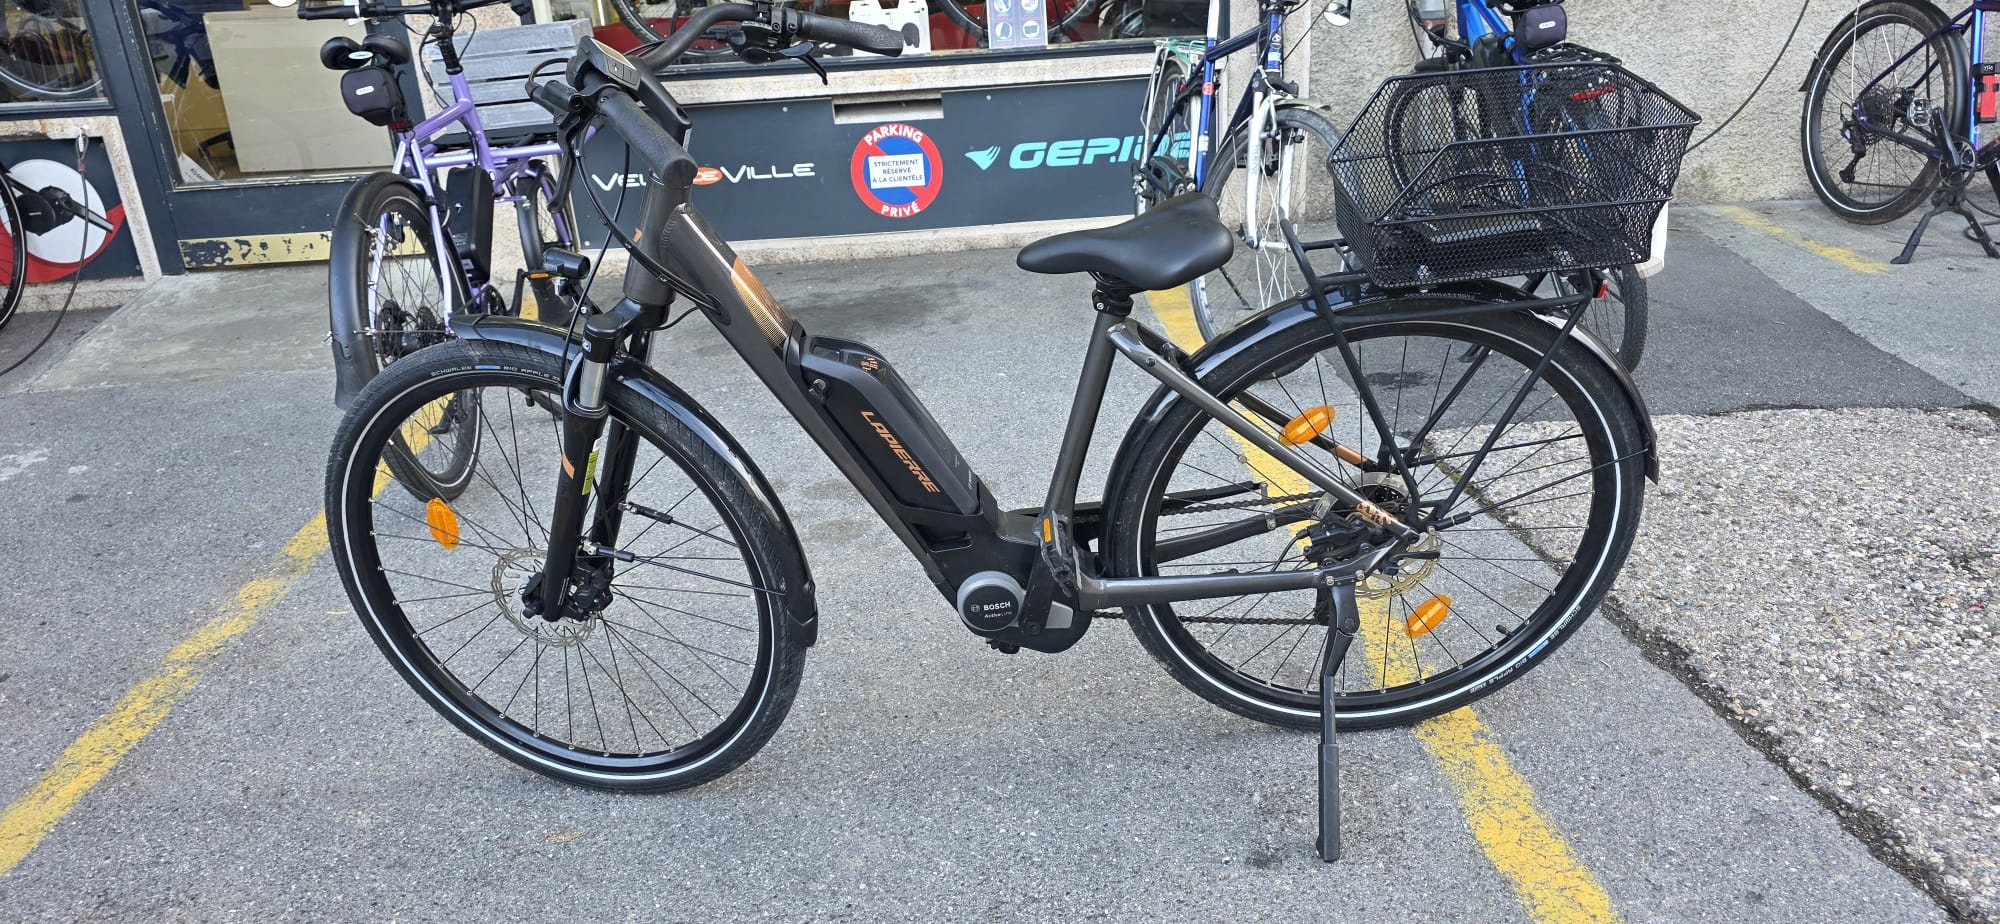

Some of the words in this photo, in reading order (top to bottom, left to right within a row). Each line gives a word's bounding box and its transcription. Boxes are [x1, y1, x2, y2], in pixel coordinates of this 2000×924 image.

[863, 124, 924, 146] PARKING
[873, 159, 919, 168] STRICTEMENT
[882, 167, 911, 175] RÉSERVÉ
[880, 200, 921, 217] PRIVÉ
[860, 411, 941, 493] LAPIERRE
[983, 600, 1011, 611] BOSCH
